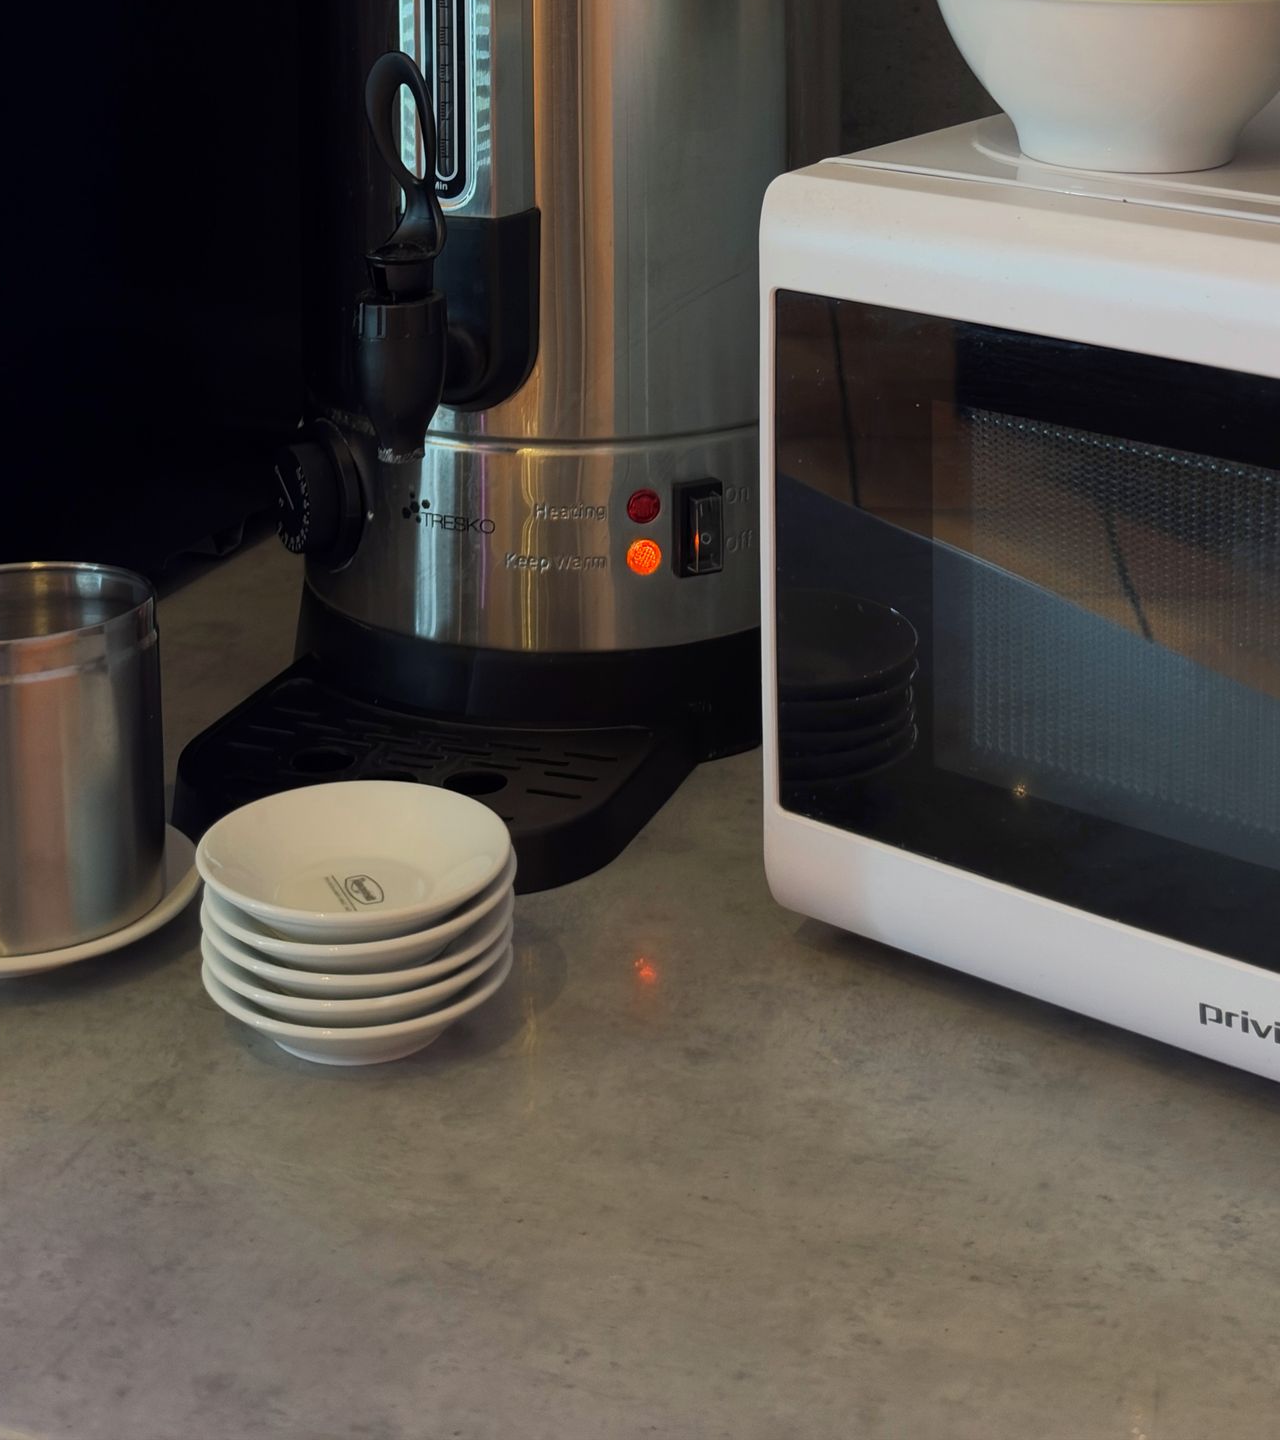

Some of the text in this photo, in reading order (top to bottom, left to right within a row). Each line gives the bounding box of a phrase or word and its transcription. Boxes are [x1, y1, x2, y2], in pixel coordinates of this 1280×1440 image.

[534, 502, 607, 521] Heating
[420, 511, 496, 535] TRESKO
[505, 552, 550, 574] Keep
